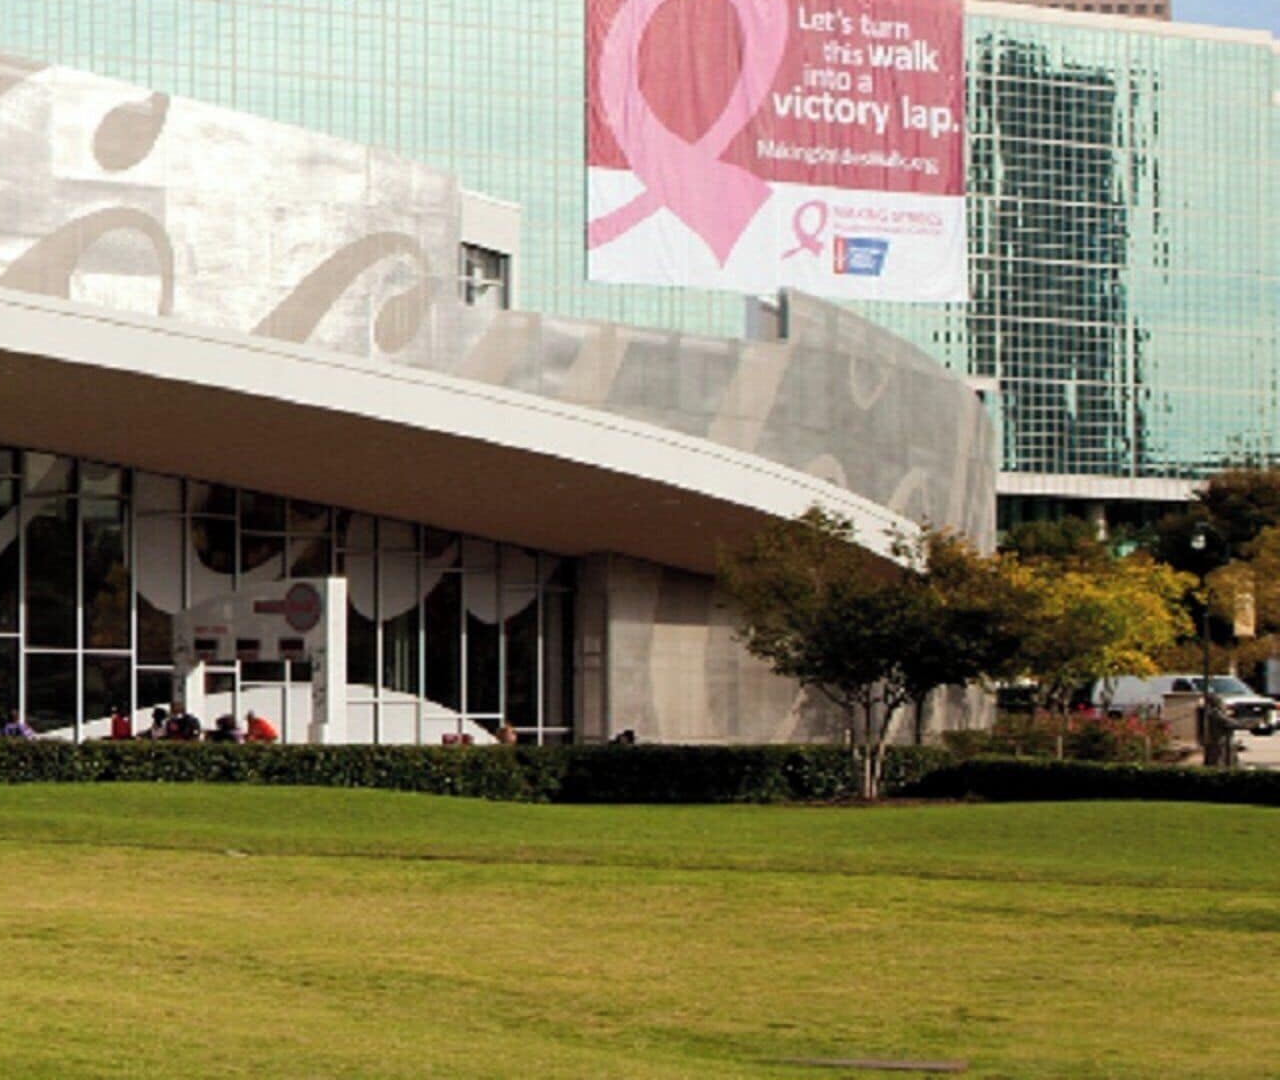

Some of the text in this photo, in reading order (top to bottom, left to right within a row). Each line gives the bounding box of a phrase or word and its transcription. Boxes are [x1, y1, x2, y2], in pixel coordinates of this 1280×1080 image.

[798, 7, 910, 39] Let's turn
[824, 41, 939, 72] this walk
[803, 64, 873, 93] into a
[773, 87, 959, 138] victory lap.
